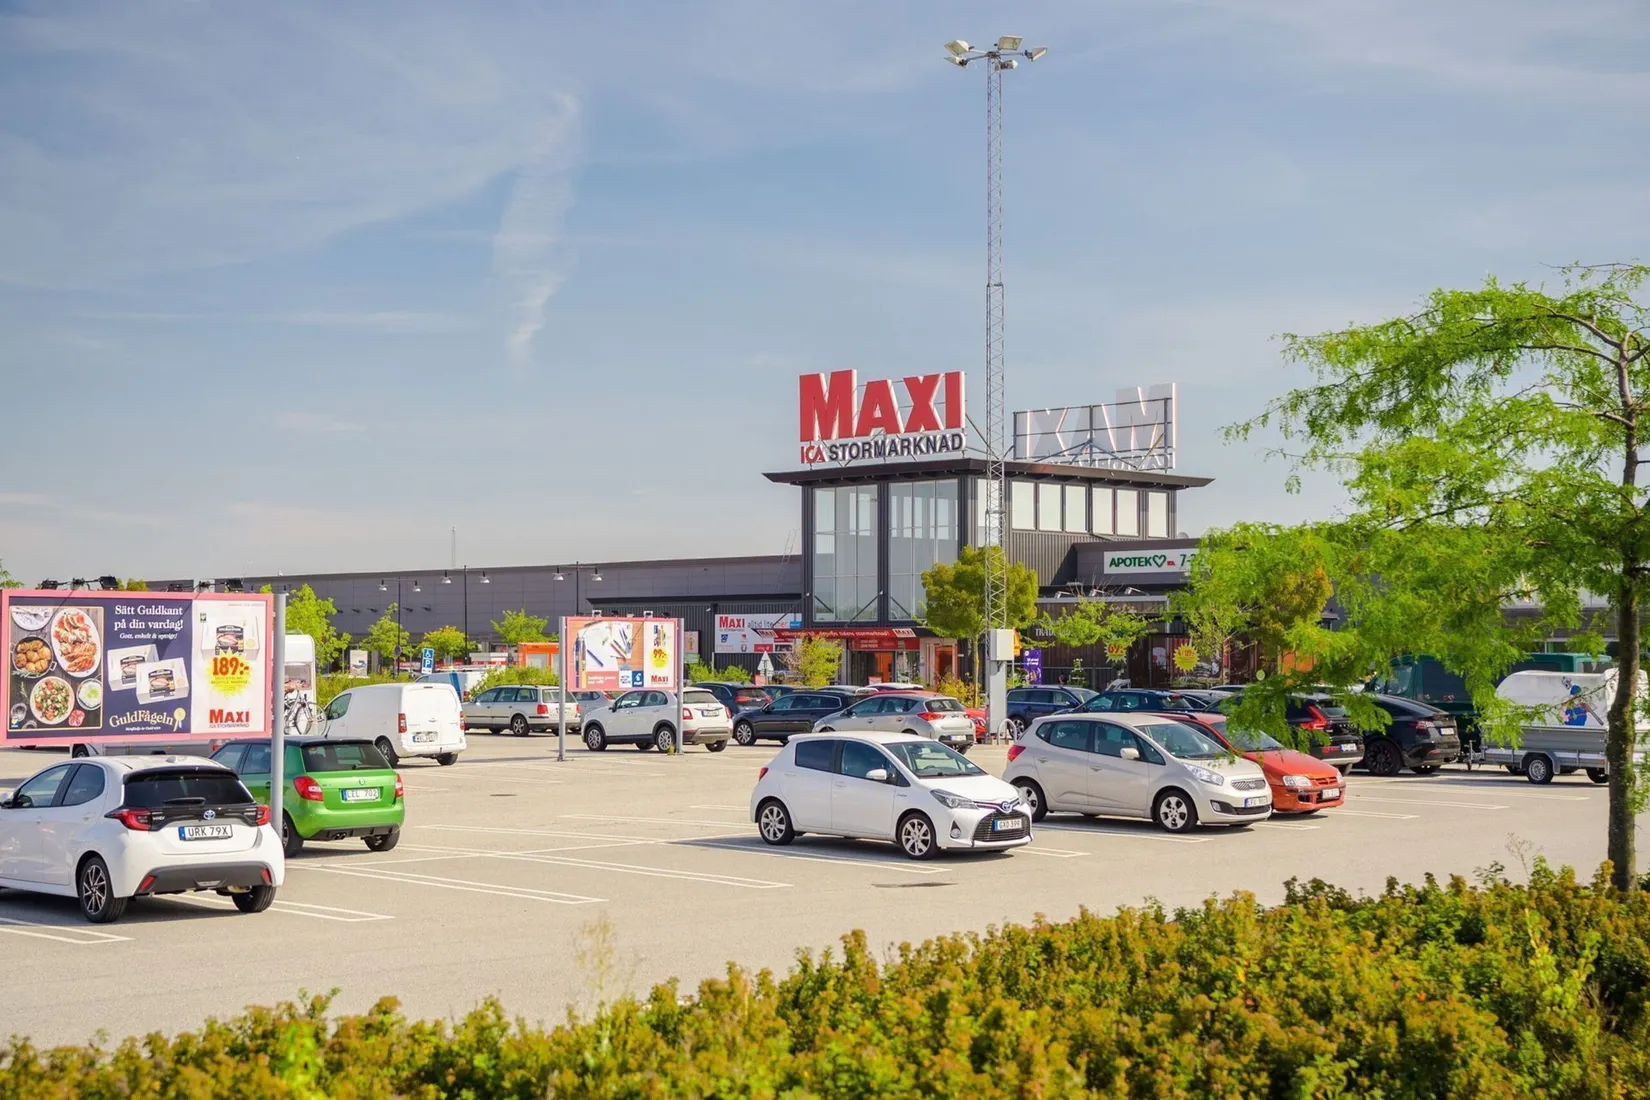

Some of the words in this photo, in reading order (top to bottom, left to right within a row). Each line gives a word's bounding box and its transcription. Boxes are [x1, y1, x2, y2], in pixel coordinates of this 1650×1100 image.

[799, 369, 965, 442] MAXI
[800, 445, 826, 464] ICA
[829, 433, 966, 461] STORMARKNAD
[1109, 556, 1152, 567] APOTEK
[115, 604, 135, 615] Sätt
[137, 605, 183, 615] Guldkant
[114, 618, 127, 631] på
[129, 618, 145, 629] din
[148, 619, 183, 631] vardag!
[719, 616, 745, 629] MAXI
[212, 656, 250, 676] 189:-
[109, 709, 174, 728] GuldFågeln
[209, 708, 250, 724] MAXI
[364, 789, 377, 797] 702
[188, 827, 207, 837] URK
[209, 826, 228, 835] 79X
